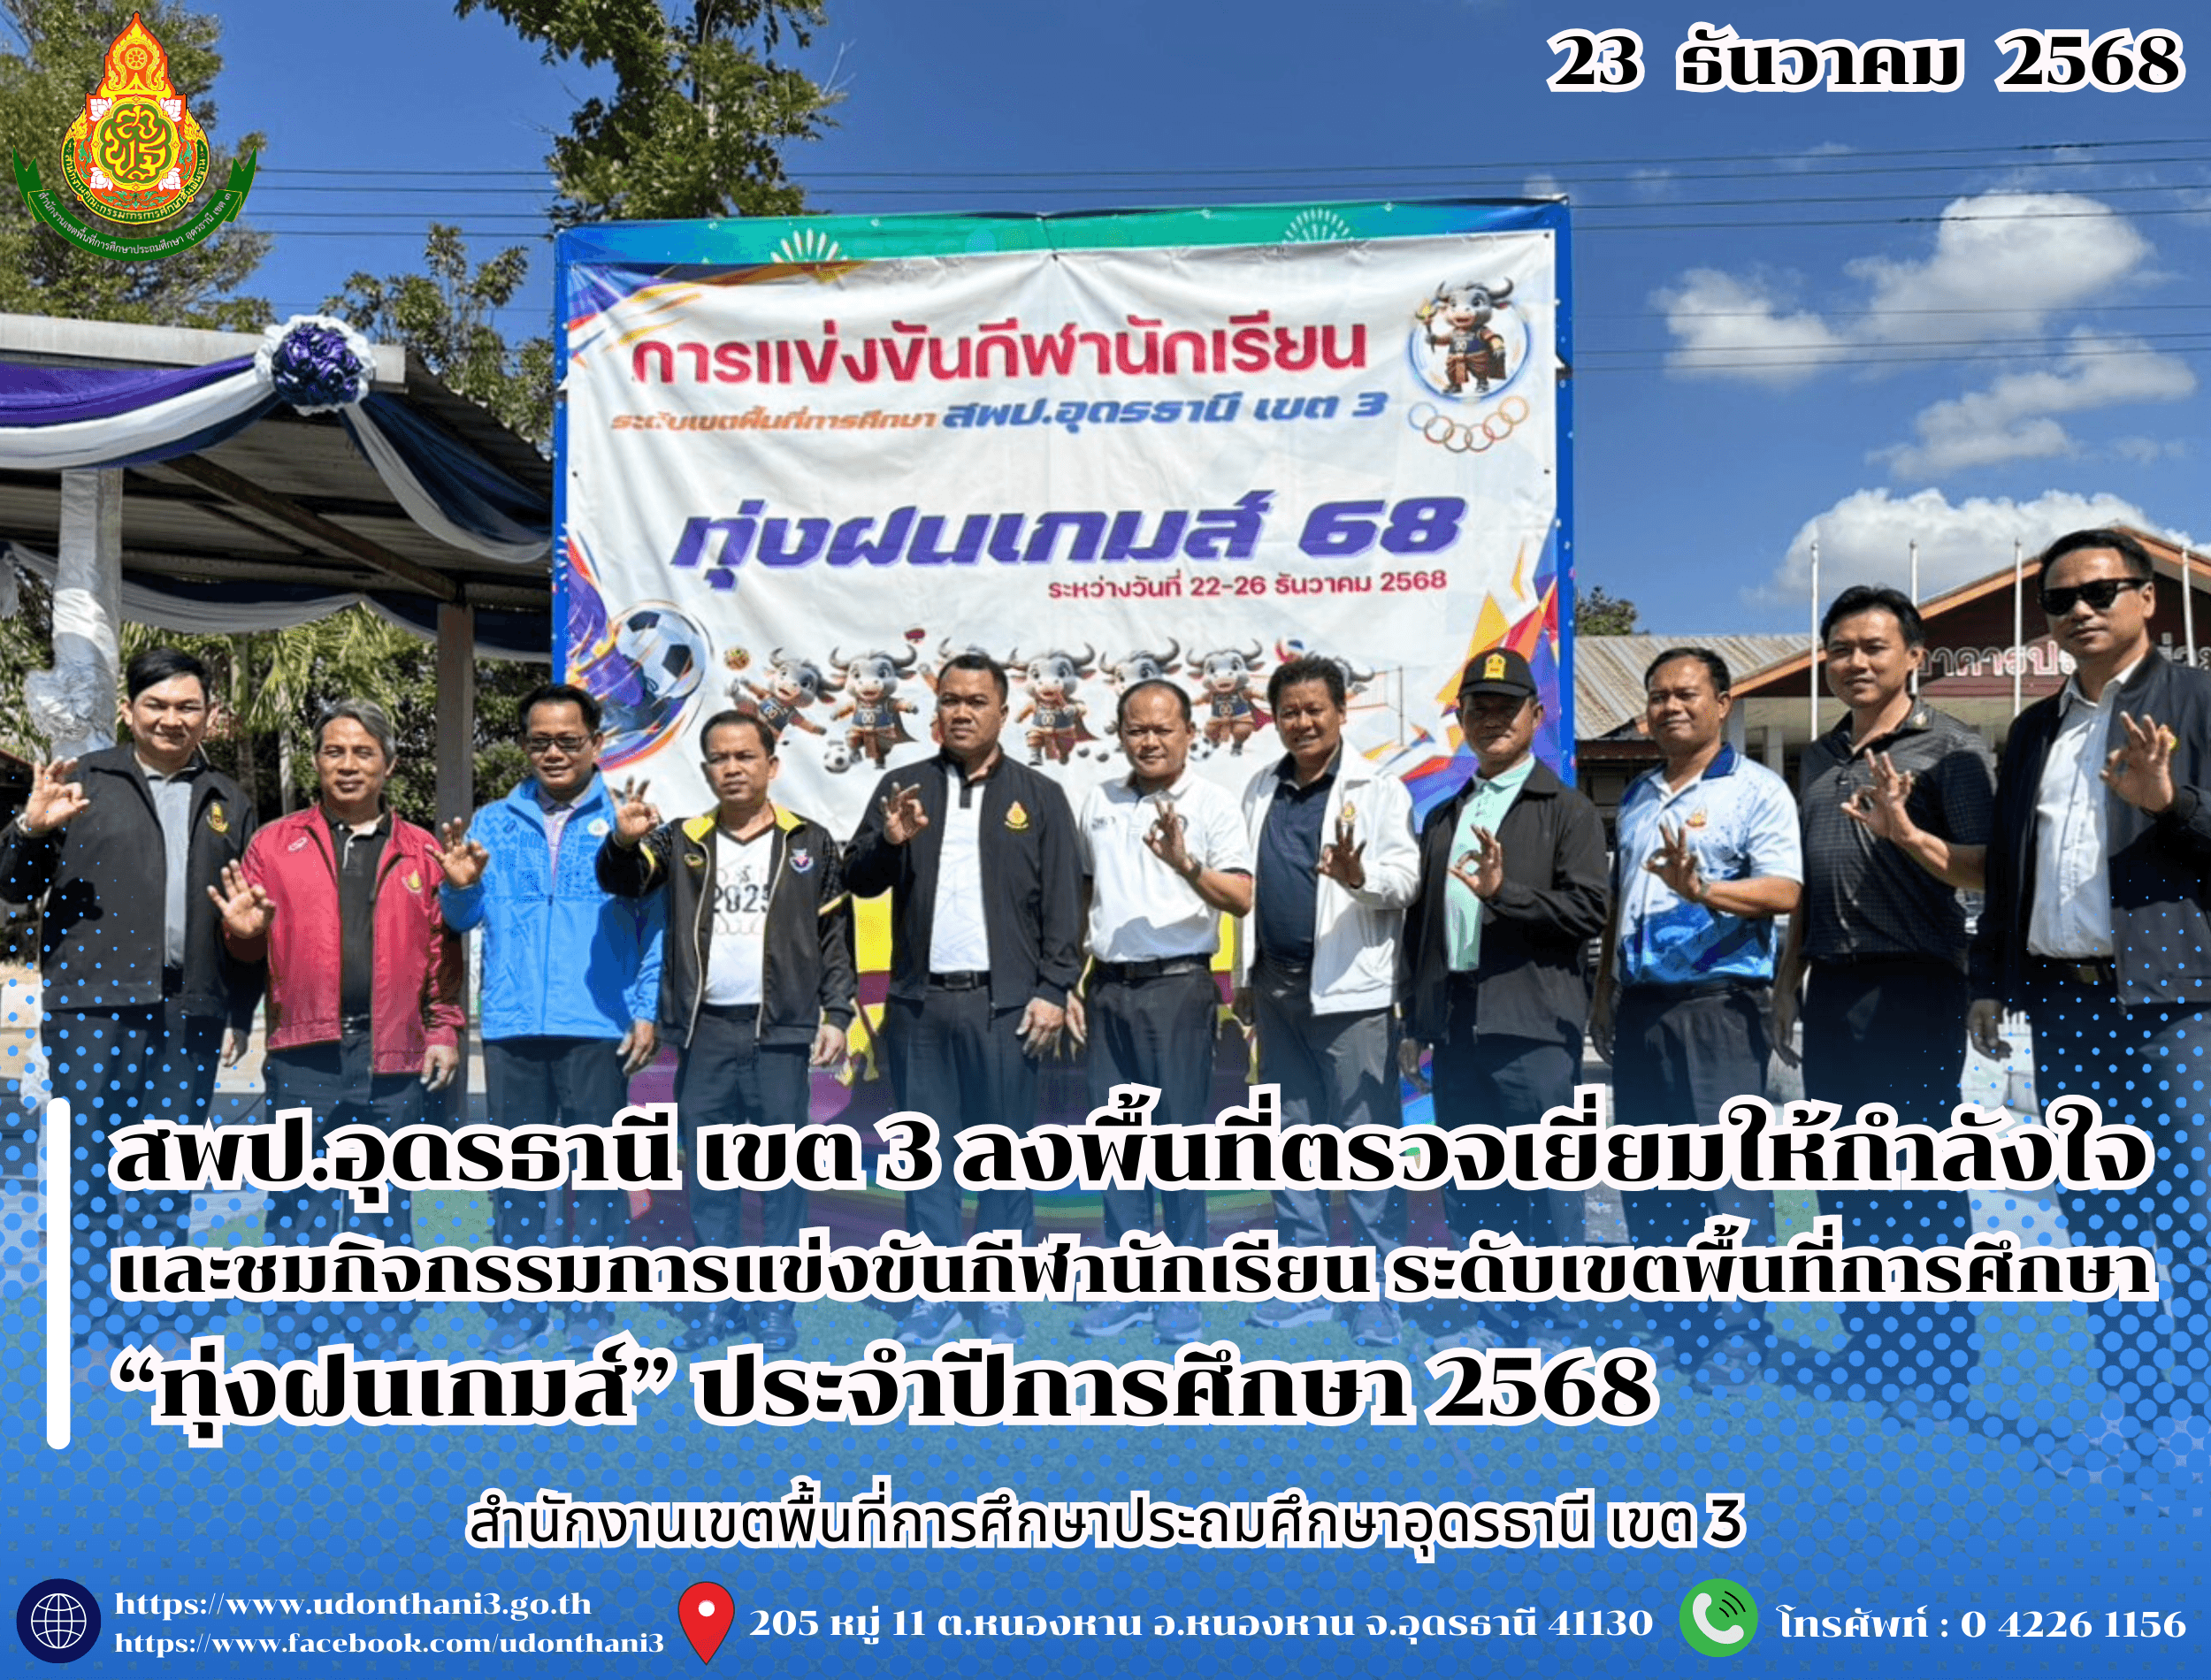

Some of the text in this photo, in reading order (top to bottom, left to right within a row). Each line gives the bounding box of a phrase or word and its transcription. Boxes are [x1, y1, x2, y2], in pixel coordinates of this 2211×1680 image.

[631, 310, 1367, 385] การแข่งขันกีฬานักเรียน
[942, 391, 1244, 434] สพป.อุดรธานี
[1252, 395, 1340, 422] เขต
[1351, 391, 1389, 417] 3
[669, 489, 1469, 592] ทุ่งฝนเกมส์ 68
[1047, 569, 1448, 599] ระหว่างวันที่ 22-26 ธันวาคม 2568
